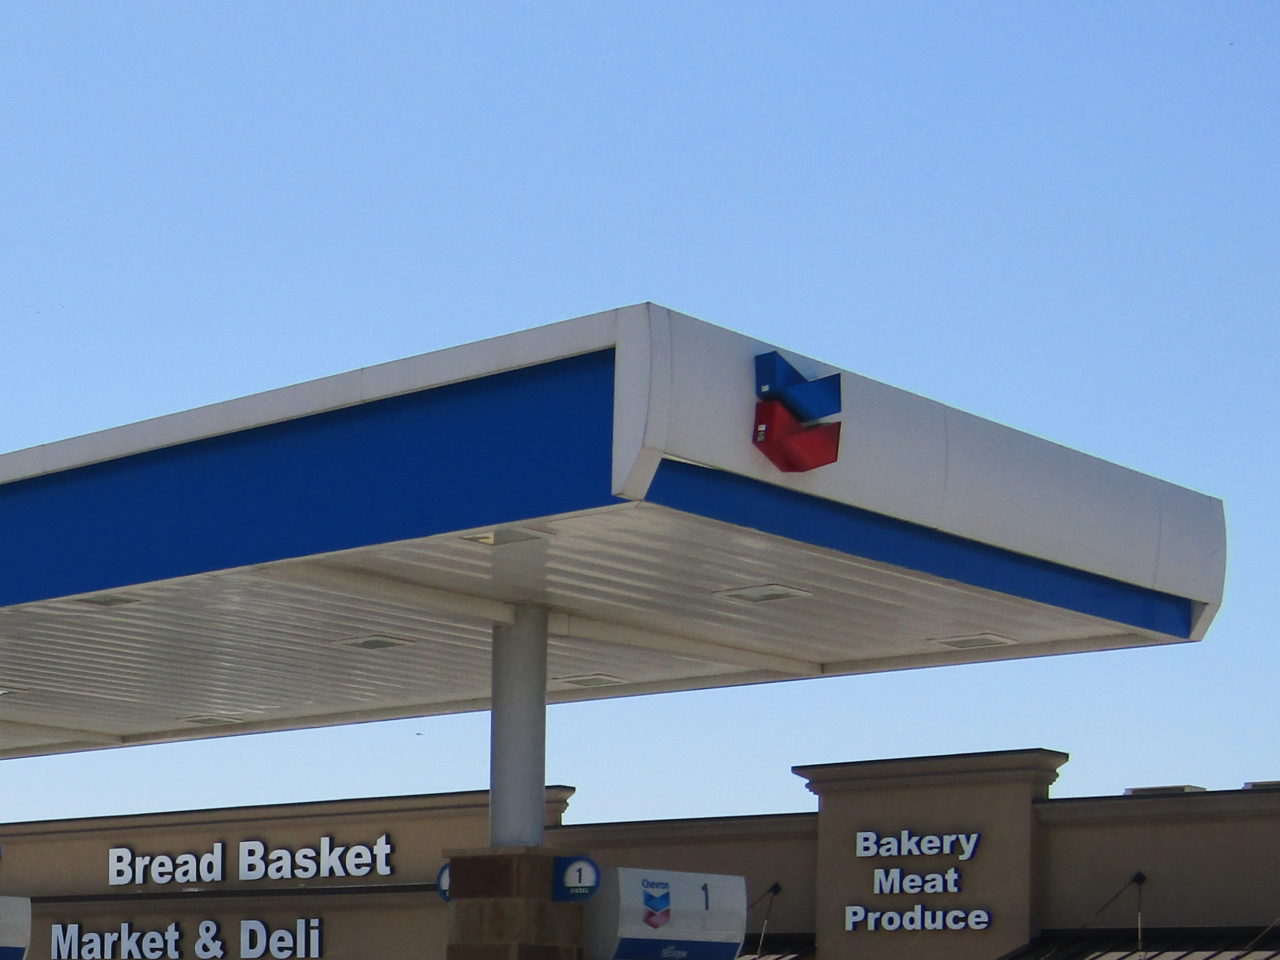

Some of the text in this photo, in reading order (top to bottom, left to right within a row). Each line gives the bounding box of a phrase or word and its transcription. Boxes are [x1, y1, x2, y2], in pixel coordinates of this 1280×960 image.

[855, 829, 980, 861] Bakery
[108, 833, 393, 886] Bread Basket
[576, 867, 583, 884] 1
[642, 879, 671, 889] Chevron
[873, 866, 960, 894] Meat
[701, 883, 709, 911] 1
[844, 904, 990, 931] Produce
[50, 918, 322, 960] Market & Deli
